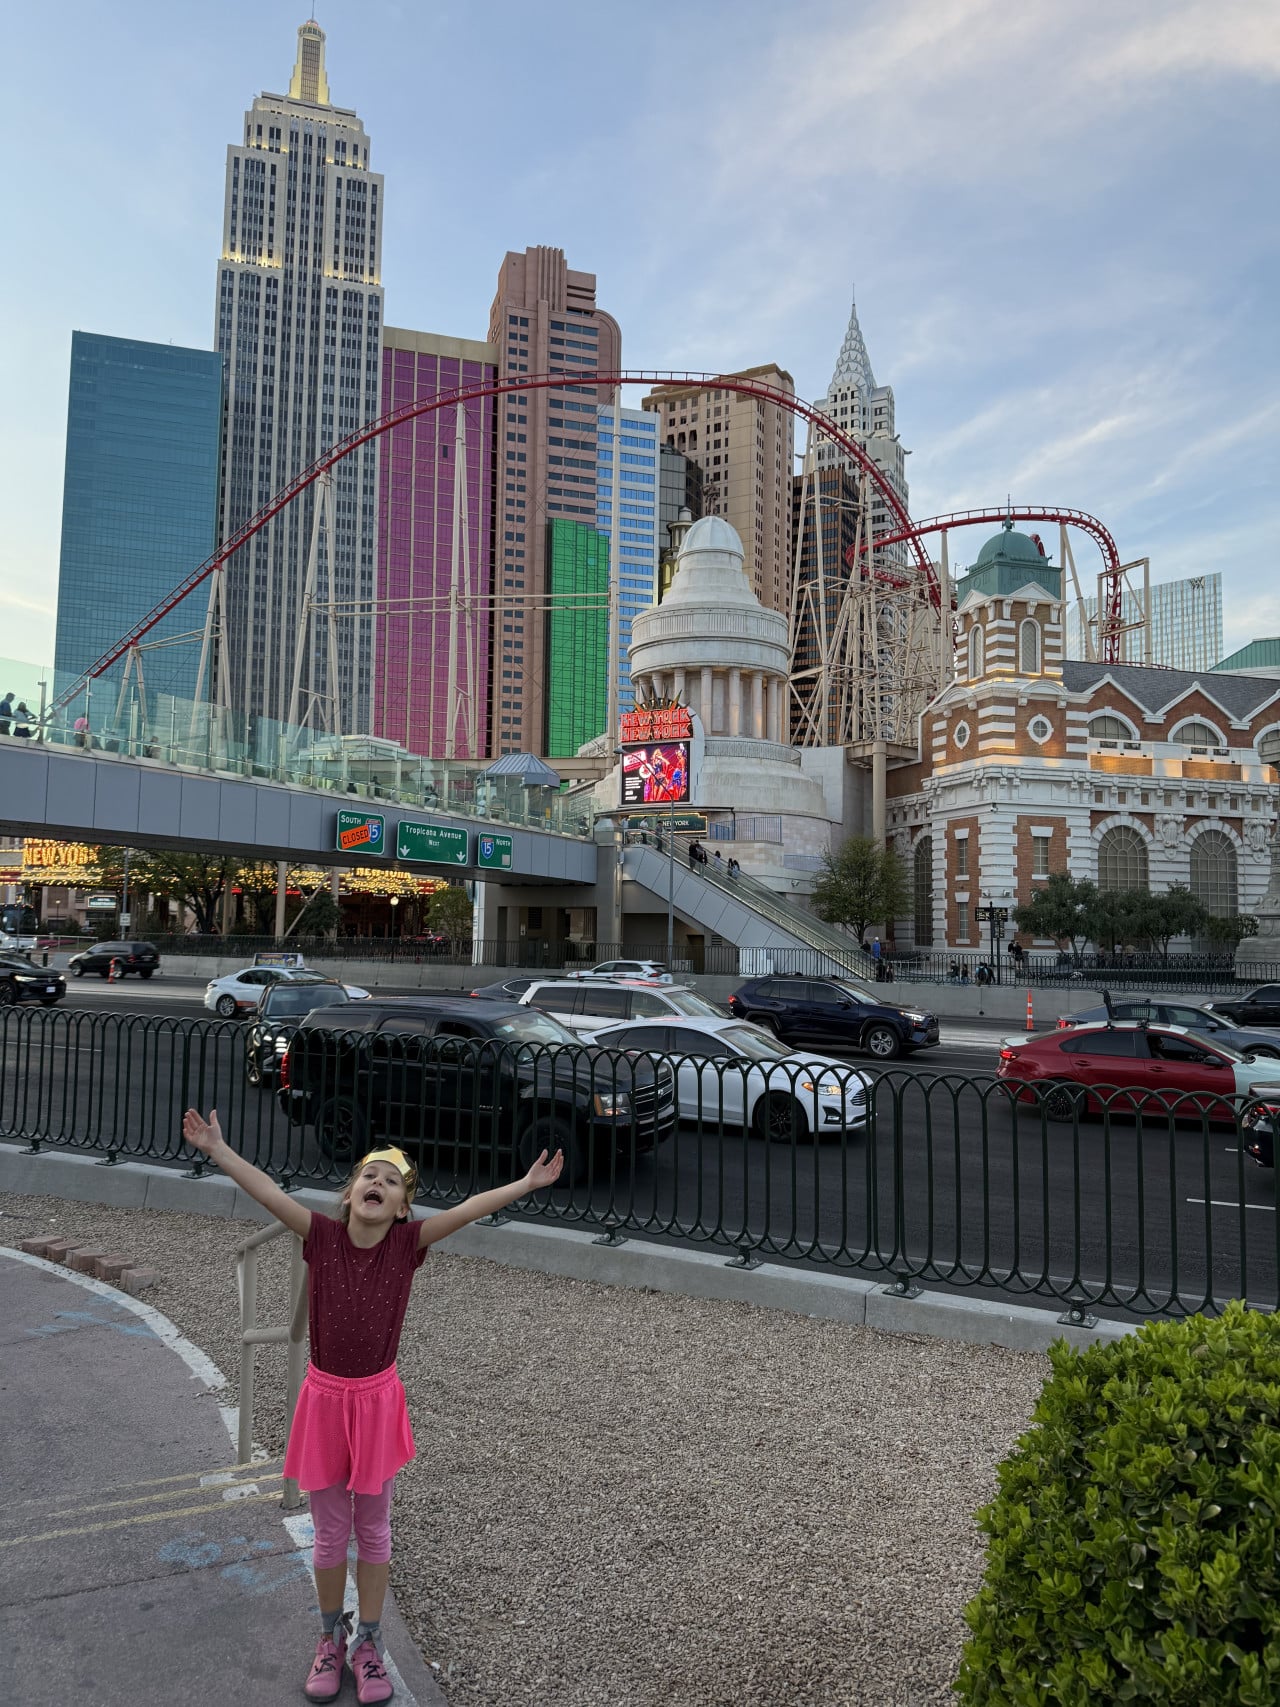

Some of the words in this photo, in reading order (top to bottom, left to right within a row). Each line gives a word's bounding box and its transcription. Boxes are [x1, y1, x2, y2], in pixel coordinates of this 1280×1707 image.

[620, 712, 651, 727] NEW
[653, 708, 691, 725] YORK
[620, 726, 651, 742] NEW
[653, 723, 690, 739] YORK
[342, 829, 369, 845] CLOSED
[369, 824, 379, 839] 15
[405, 825, 436, 837] Tropicana
[439, 830, 462, 840] Avenue
[23, 846, 56, 866] NEW
[484, 842, 492, 854] 15
